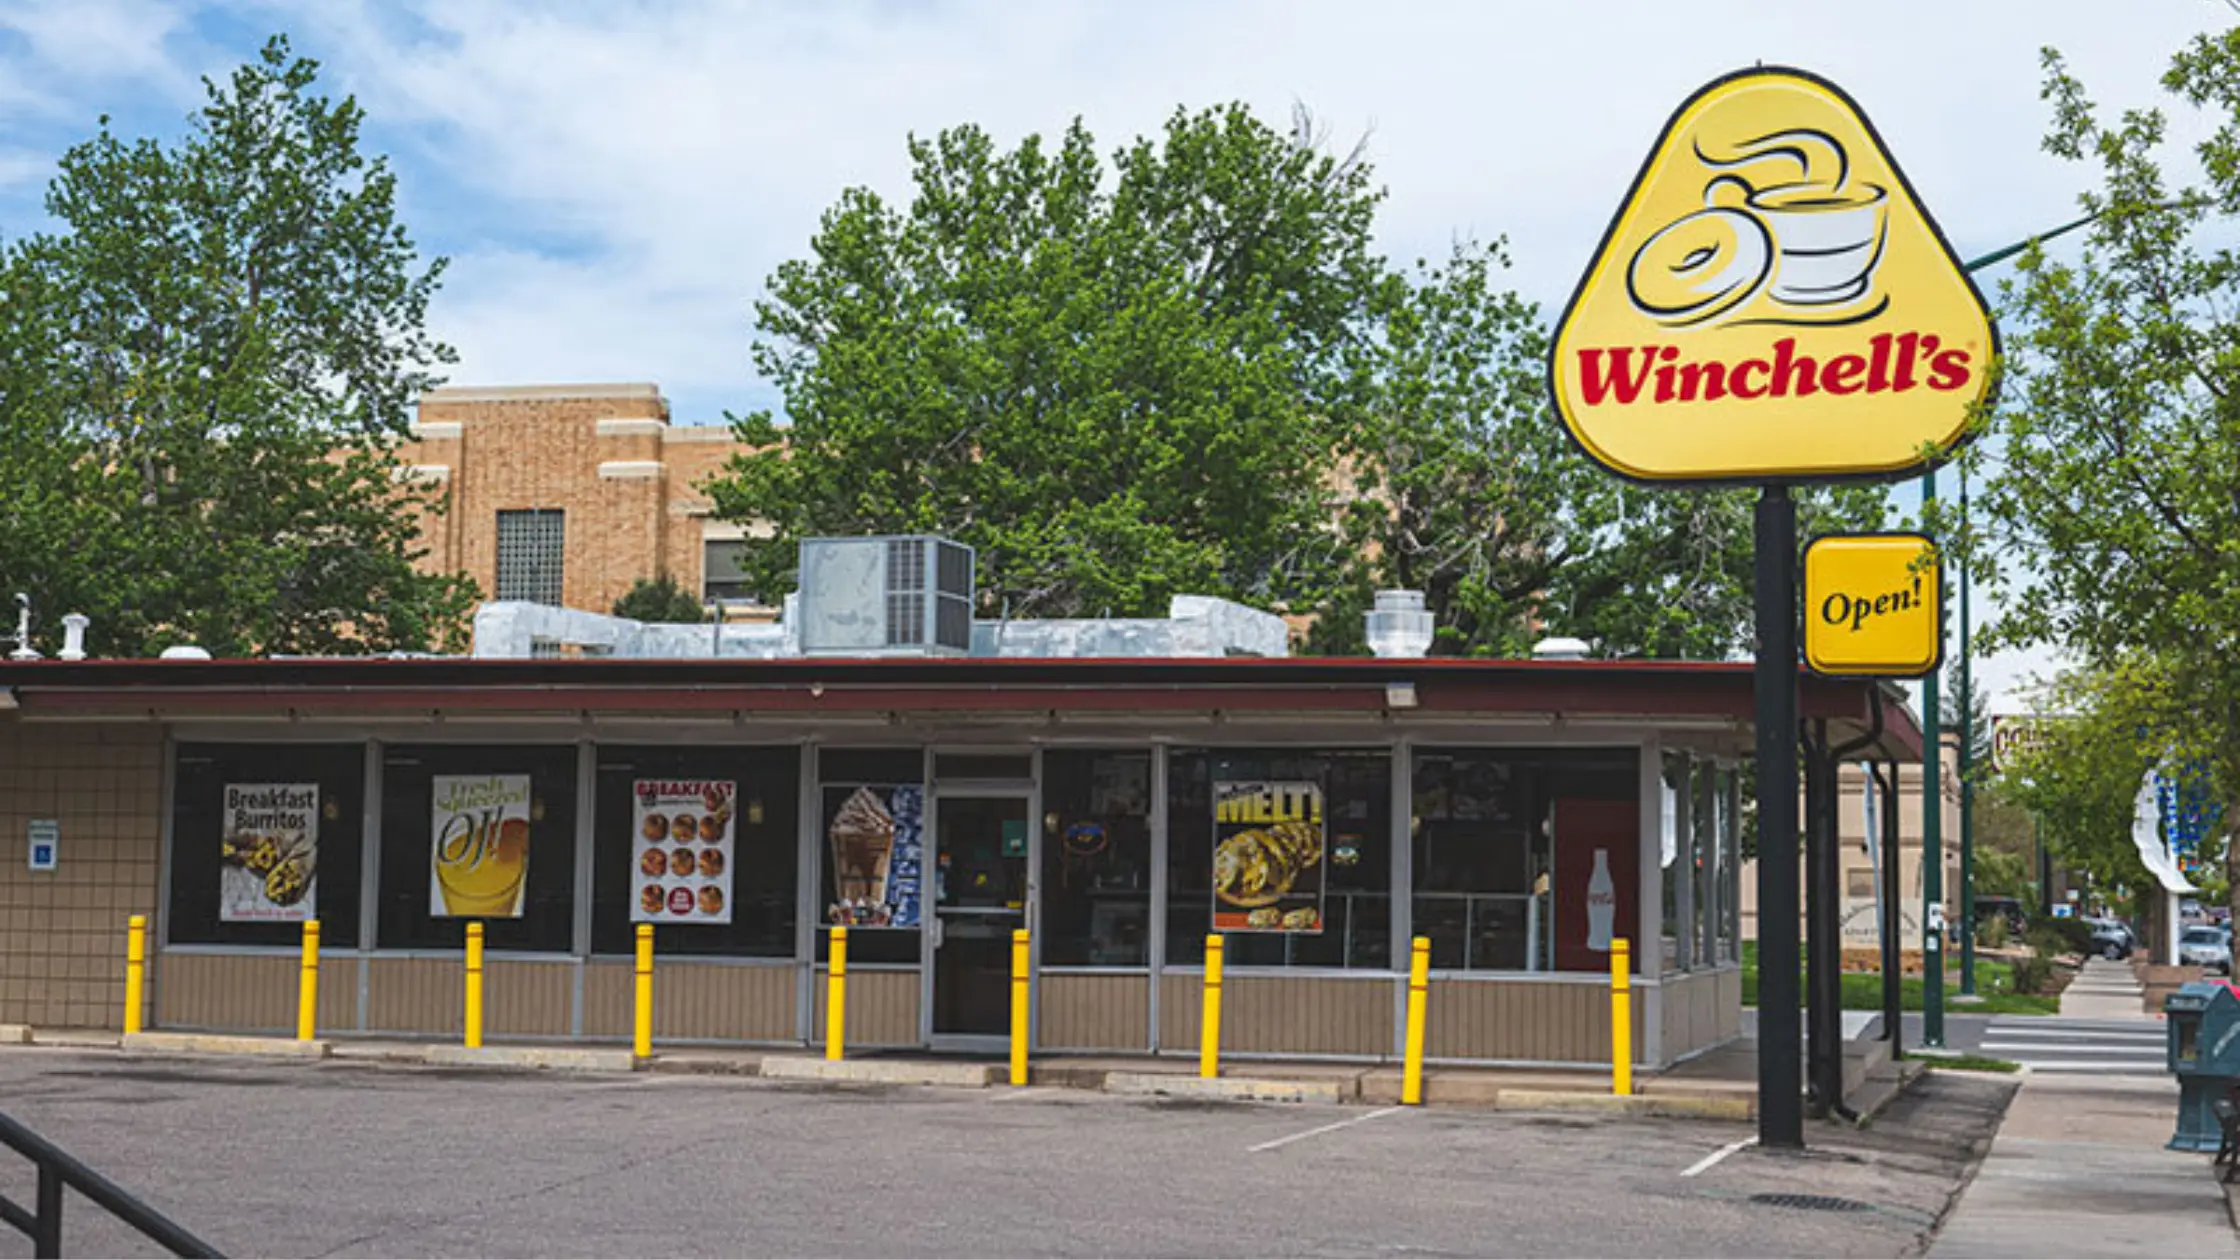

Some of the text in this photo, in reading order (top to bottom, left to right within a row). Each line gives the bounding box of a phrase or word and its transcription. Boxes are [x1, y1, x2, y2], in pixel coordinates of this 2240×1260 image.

[1577, 331, 1971, 406] Winchell's
[1821, 576, 1922, 632] Open!
[228, 787, 315, 810] Breakfast
[636, 781, 733, 797] BREAKFAST
[1216, 783, 1323, 824] MELT!
[234, 807, 306, 829] Burritos
[437, 805, 504, 869] OJ!
